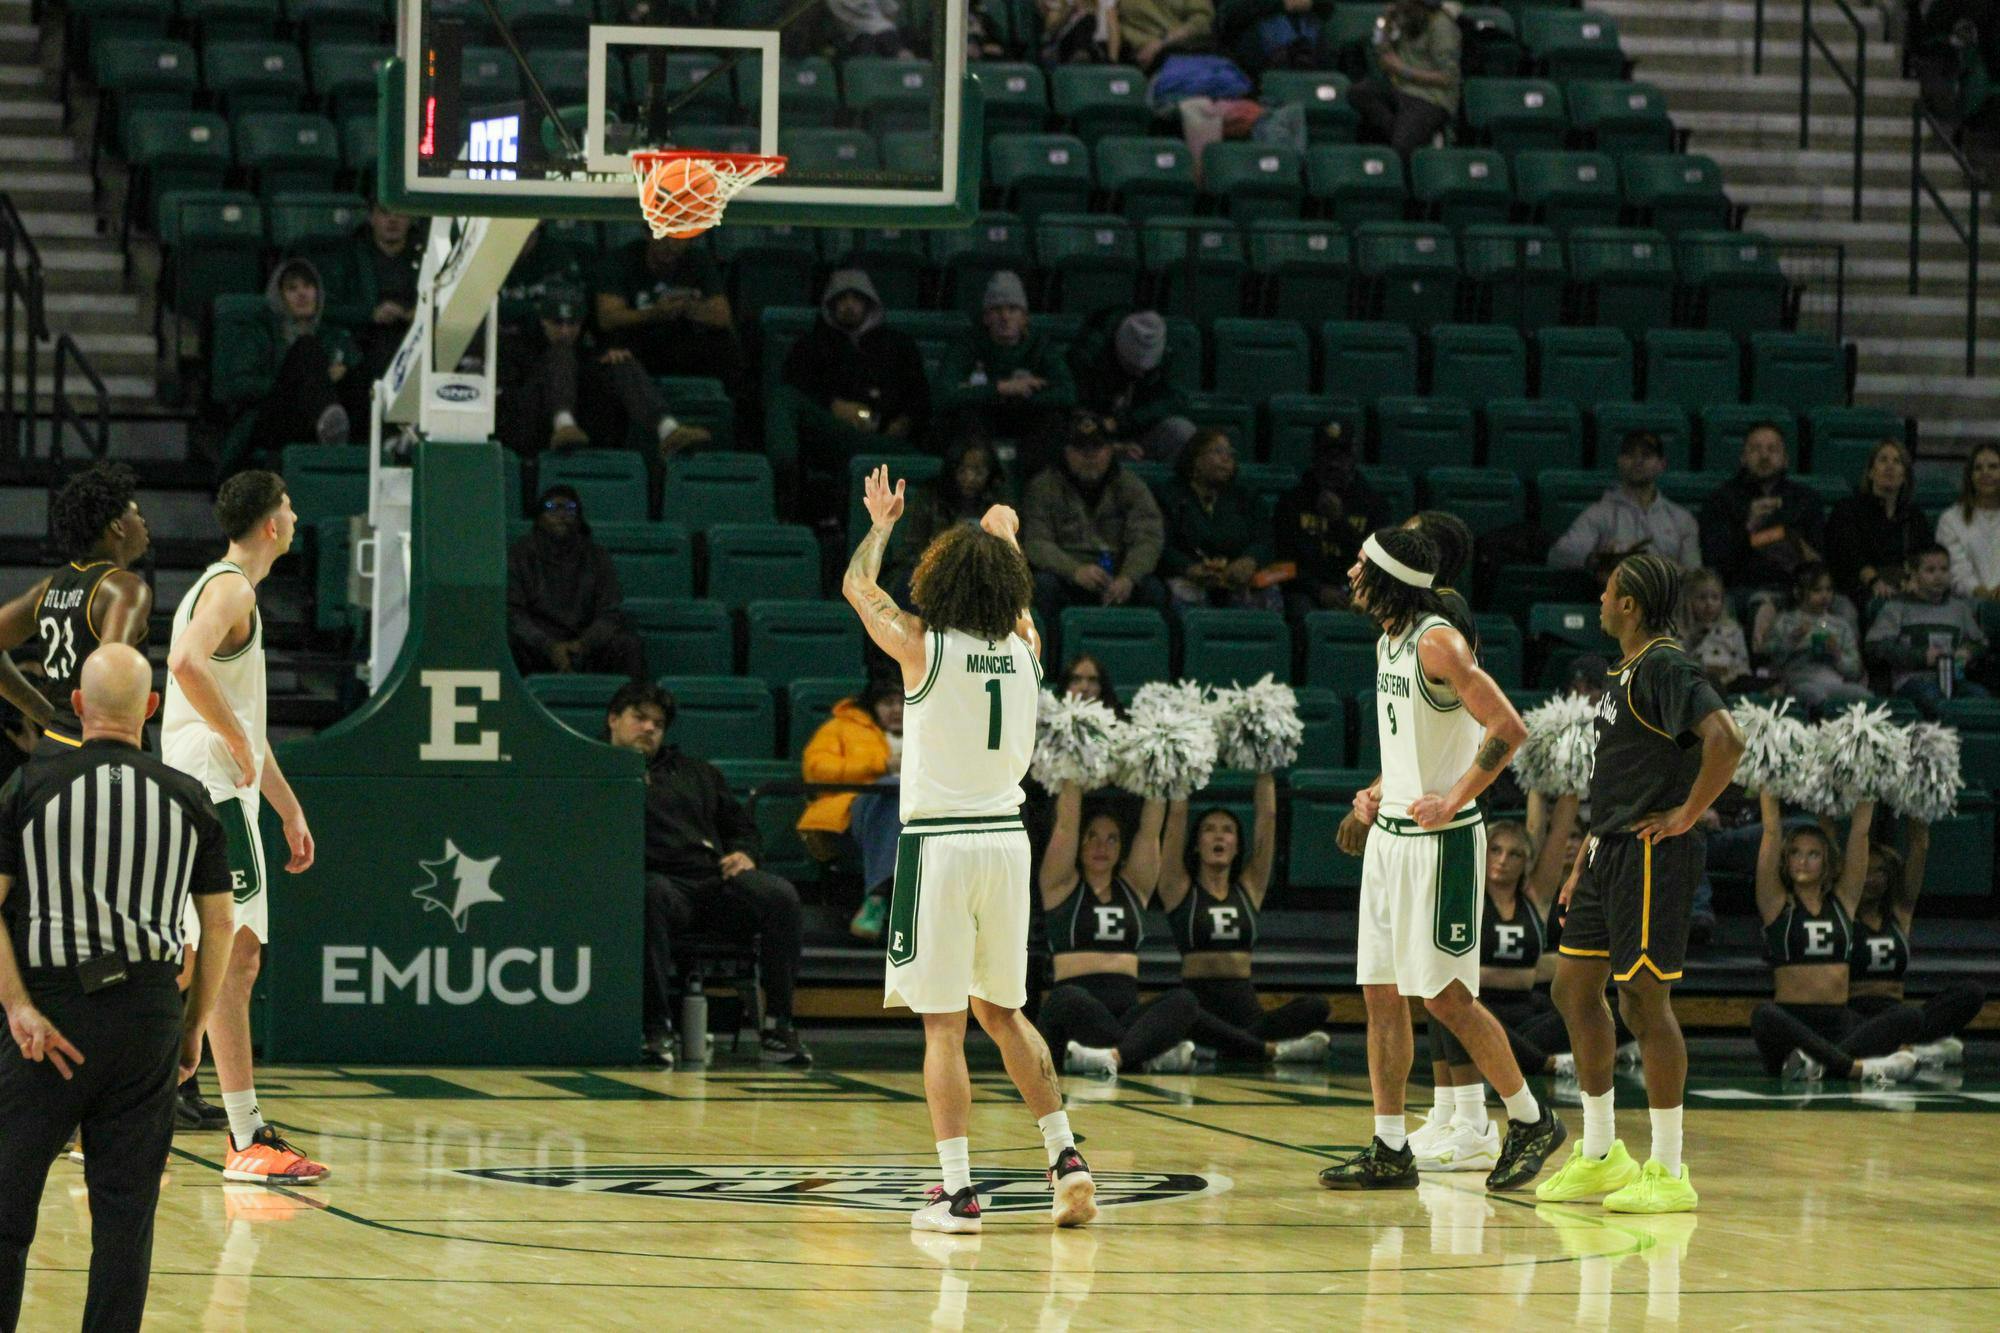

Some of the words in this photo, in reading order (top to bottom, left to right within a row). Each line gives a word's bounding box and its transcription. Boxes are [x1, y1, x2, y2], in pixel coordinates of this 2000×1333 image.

[40, 617, 77, 680] 23
[966, 653, 1016, 674] MANCIEL
[420, 670, 500, 761] E
[985, 679, 1002, 750] 1
[1387, 702, 1397, 735] 9
[230, 870, 248, 890] E
[1094, 906, 1126, 941] E
[1208, 906, 1241, 941] E
[1450, 923, 1466, 942] E
[1803, 921, 1834, 956] E
[893, 930, 904, 953] E
[1493, 924, 1525, 960] E
[1865, 937, 1896, 972] E
[321, 945, 591, 1005] EMUCU
